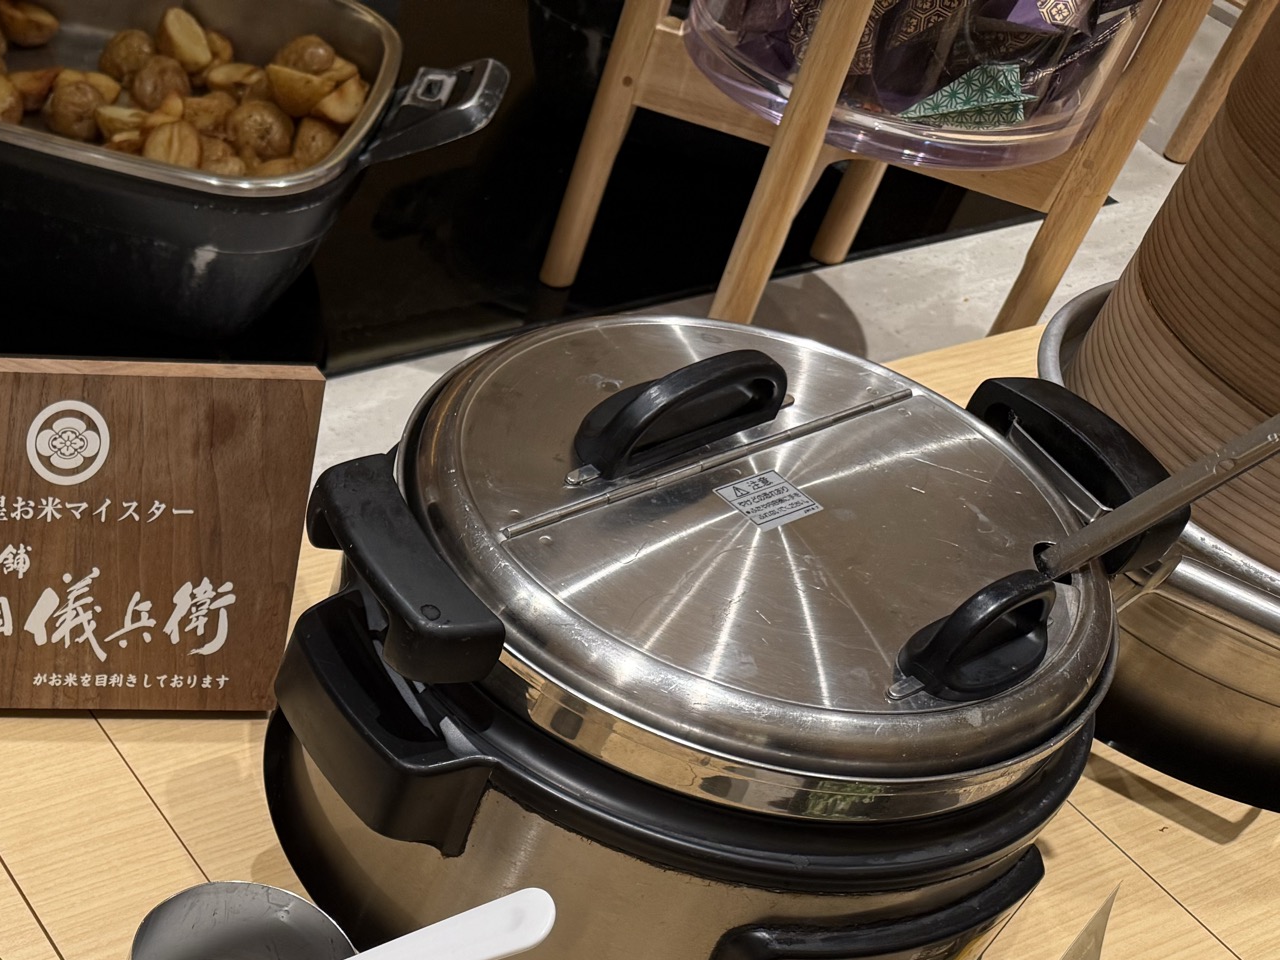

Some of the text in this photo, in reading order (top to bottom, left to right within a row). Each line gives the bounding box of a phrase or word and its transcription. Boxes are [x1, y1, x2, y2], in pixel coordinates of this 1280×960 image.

[32, 672, 230, 690] がお米を目利きしております
